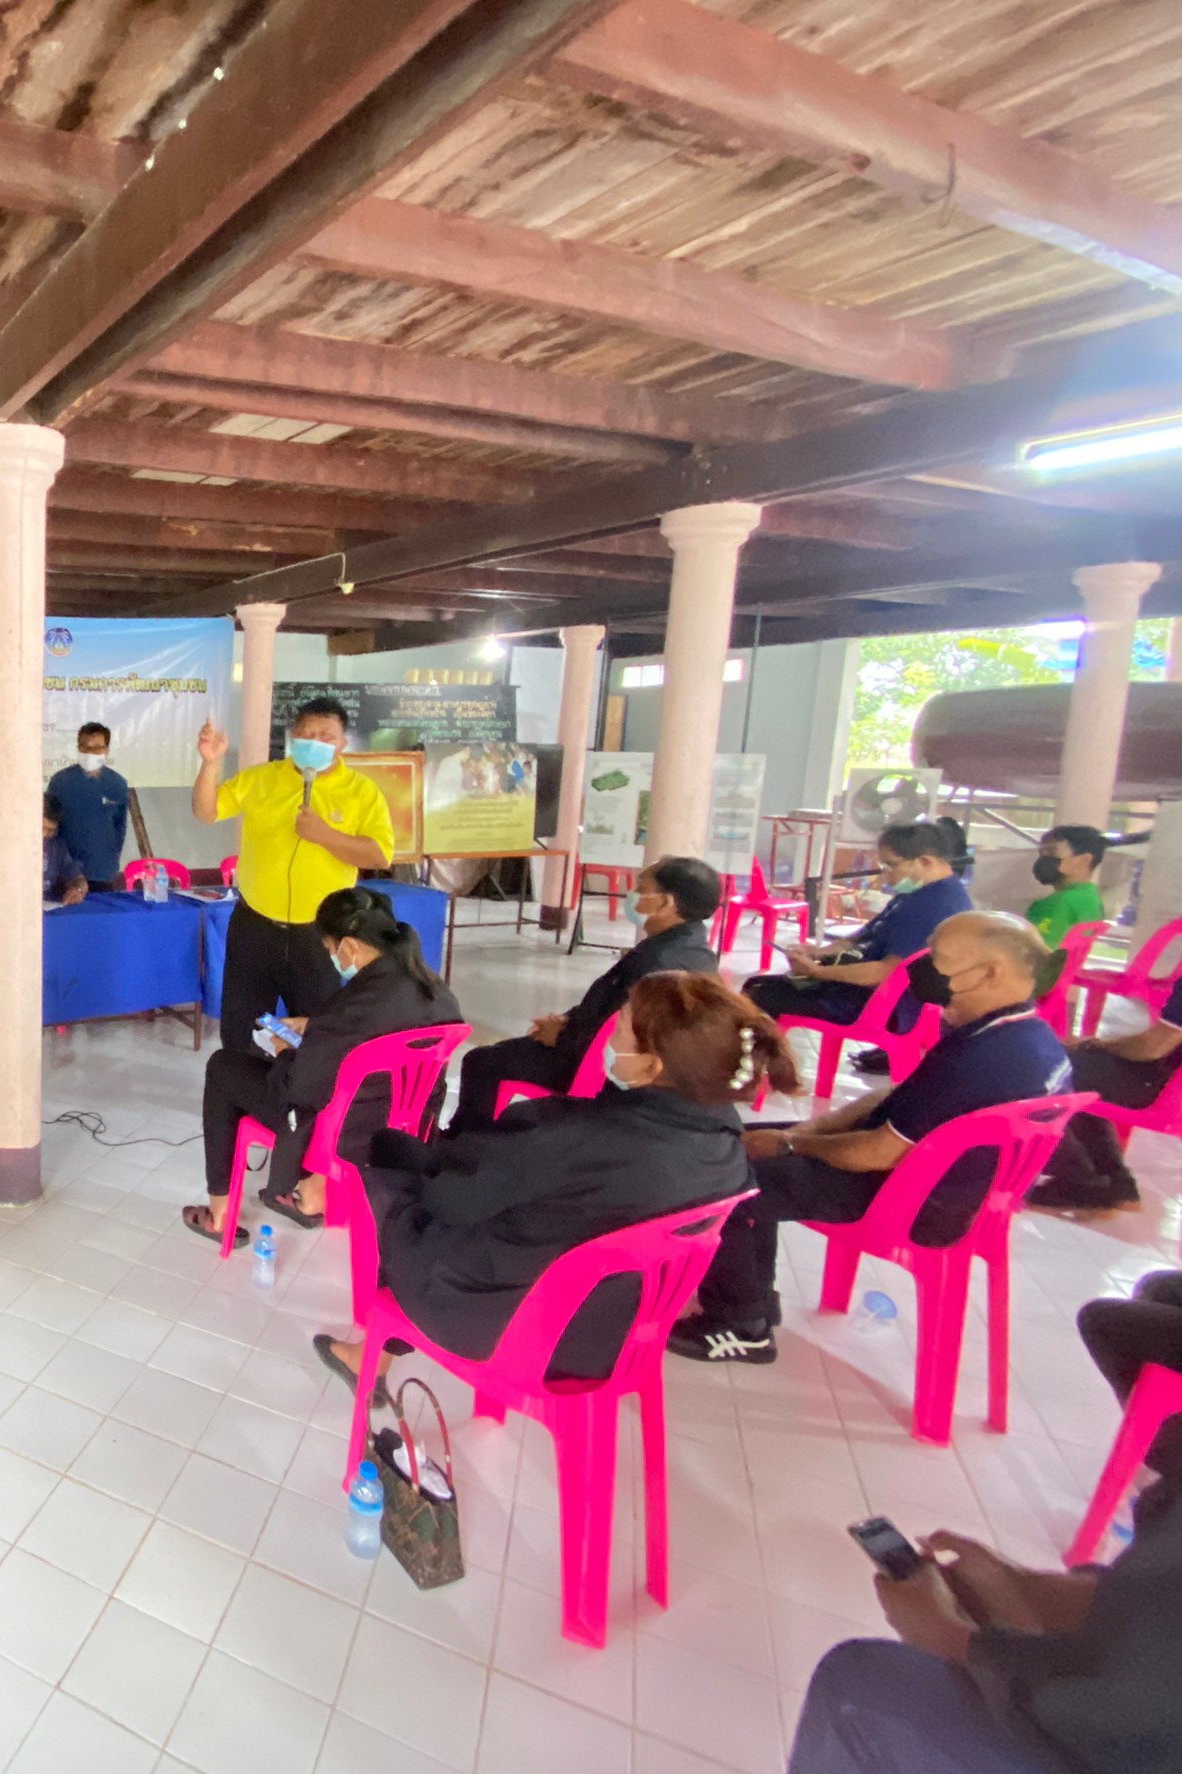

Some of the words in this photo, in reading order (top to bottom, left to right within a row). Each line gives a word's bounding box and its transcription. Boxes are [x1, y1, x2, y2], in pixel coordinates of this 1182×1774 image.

[68, 672, 208, 699] กรมการพัฒนาชุมชน
